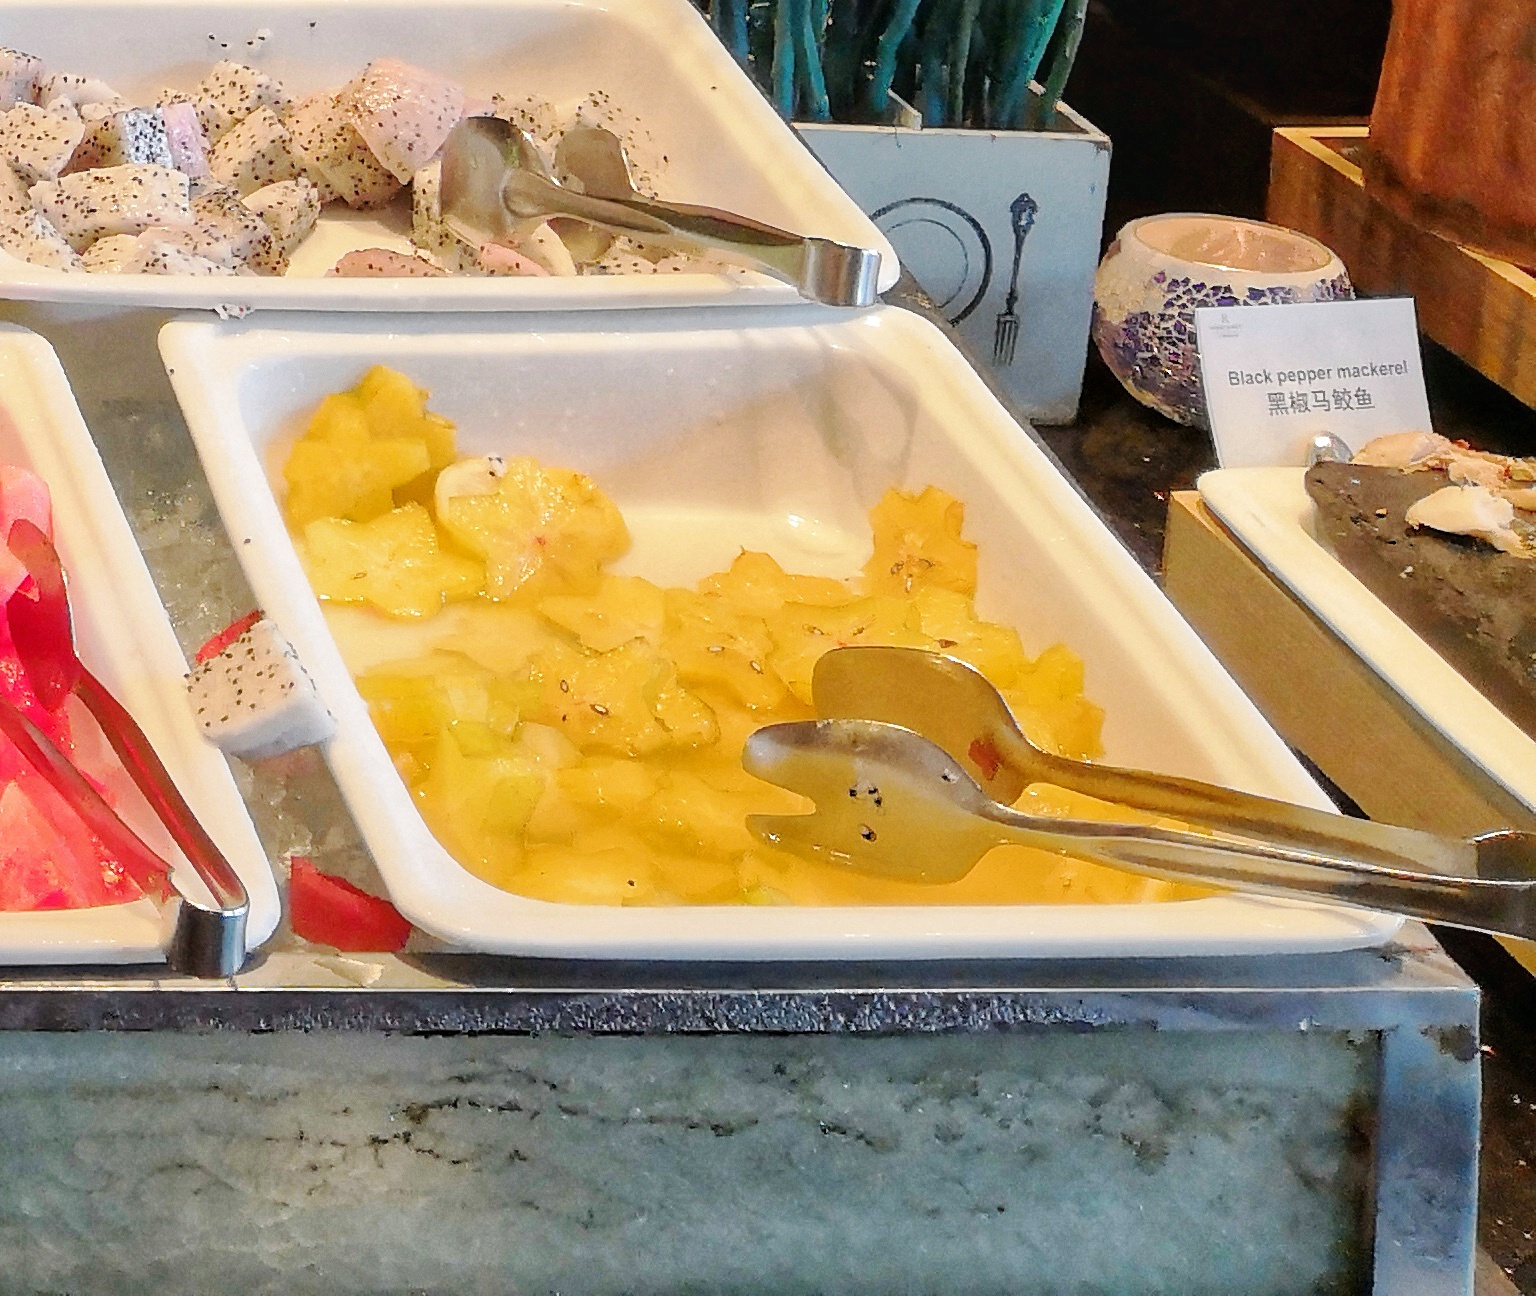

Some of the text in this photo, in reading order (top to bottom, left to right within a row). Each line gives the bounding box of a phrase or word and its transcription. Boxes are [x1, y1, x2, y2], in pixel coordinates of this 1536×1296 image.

[1228, 359, 1409, 386] Black pepper mackerel
[1267, 386, 1376, 416] 黑椒马鲛鱼
